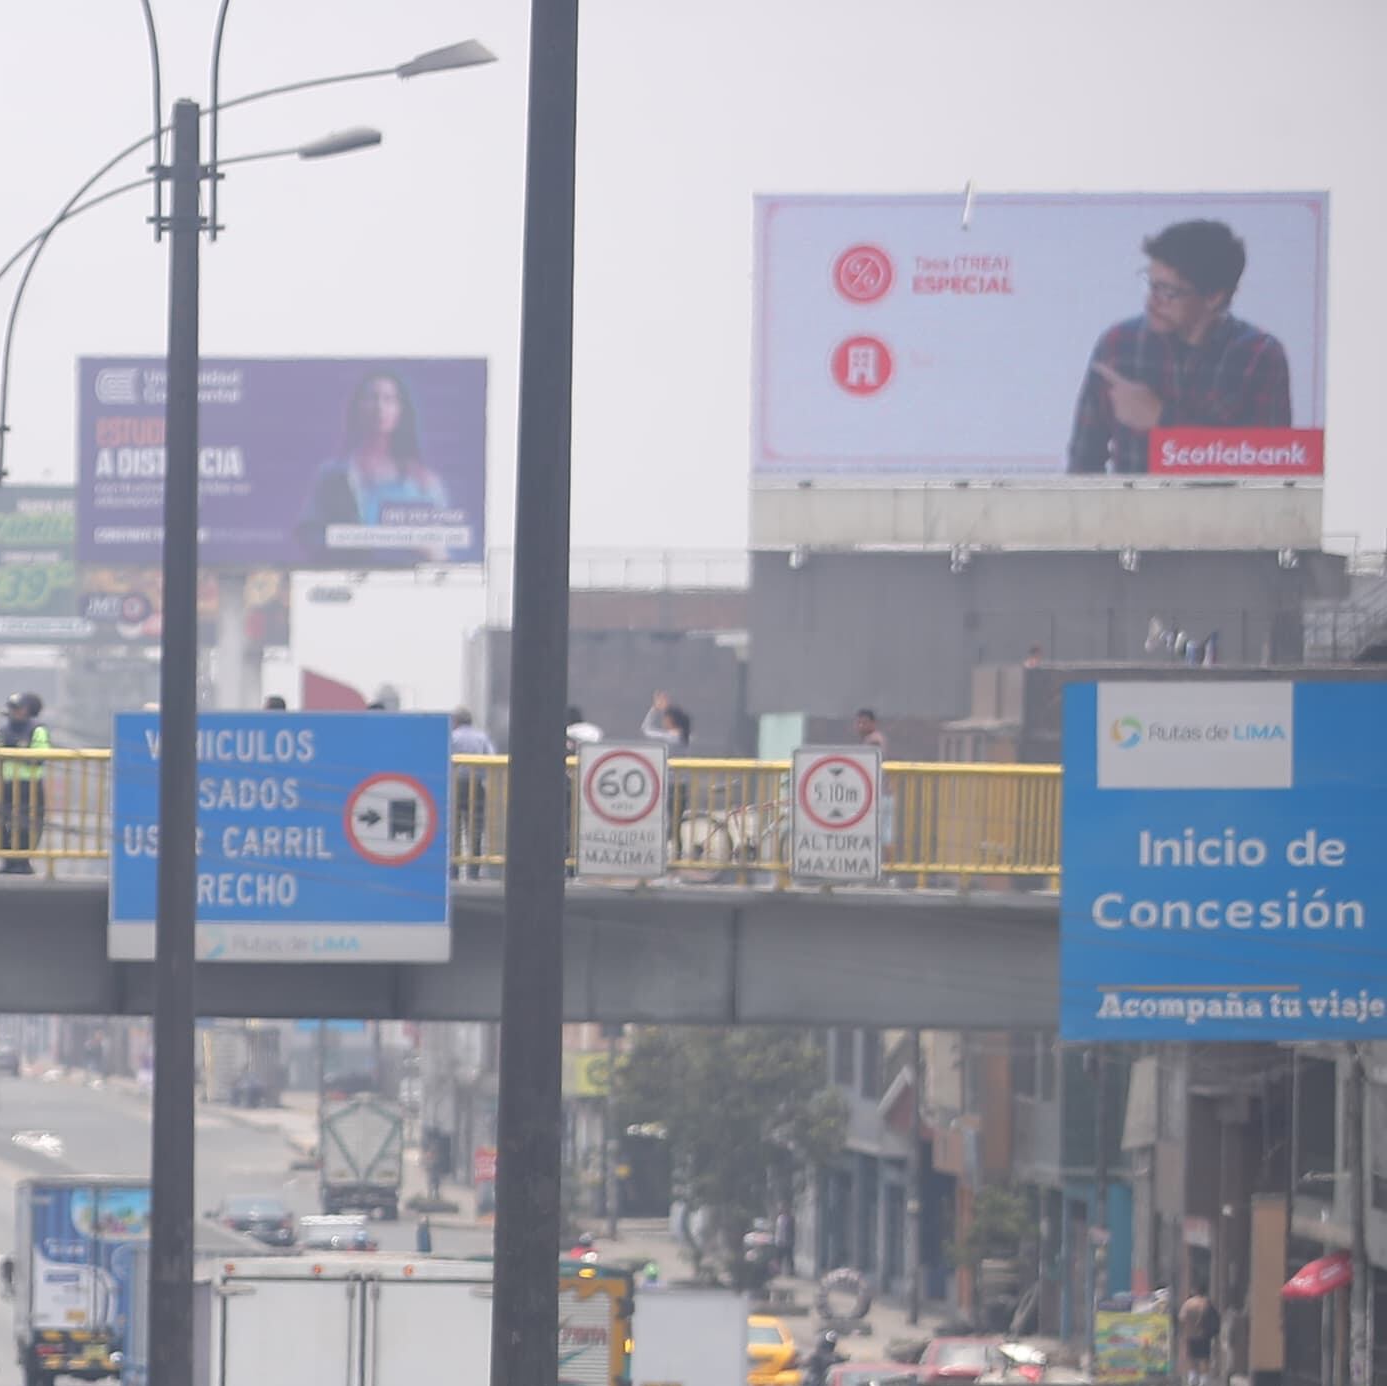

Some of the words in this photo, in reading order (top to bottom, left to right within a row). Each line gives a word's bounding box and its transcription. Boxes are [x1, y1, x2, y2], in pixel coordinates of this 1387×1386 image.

[912, 275, 1013, 295] ESPECIAL
[96, 449, 114, 476] A
[117, 449, 242, 476] DISTCIA
[1160, 442, 1308, 466] Scotiabank
[145, 729, 315, 762] VHICULOS
[1148, 724, 1202, 741] Rutas
[1205, 724, 1228, 741] de
[1233, 724, 1285, 741] LIMA
[199, 778, 299, 810] SADOS
[598, 768, 645, 799] 60
[222, 826, 332, 860] CARRIL
[585, 851, 655, 865] MAXIMA
[799, 835, 872, 851] ALTURA
[1138, 828, 1268, 867] Inicio
[1286, 829, 1346, 867] de
[798, 858, 871, 873] MAXIMA
[197, 873, 298, 905] RECHO
[1092, 888, 1365, 929] Concesión
[1096, 989, 1263, 1024] Acompaña
[1270, 997, 1302, 1018] tu
[1308, 989, 1387, 1022] viaje
